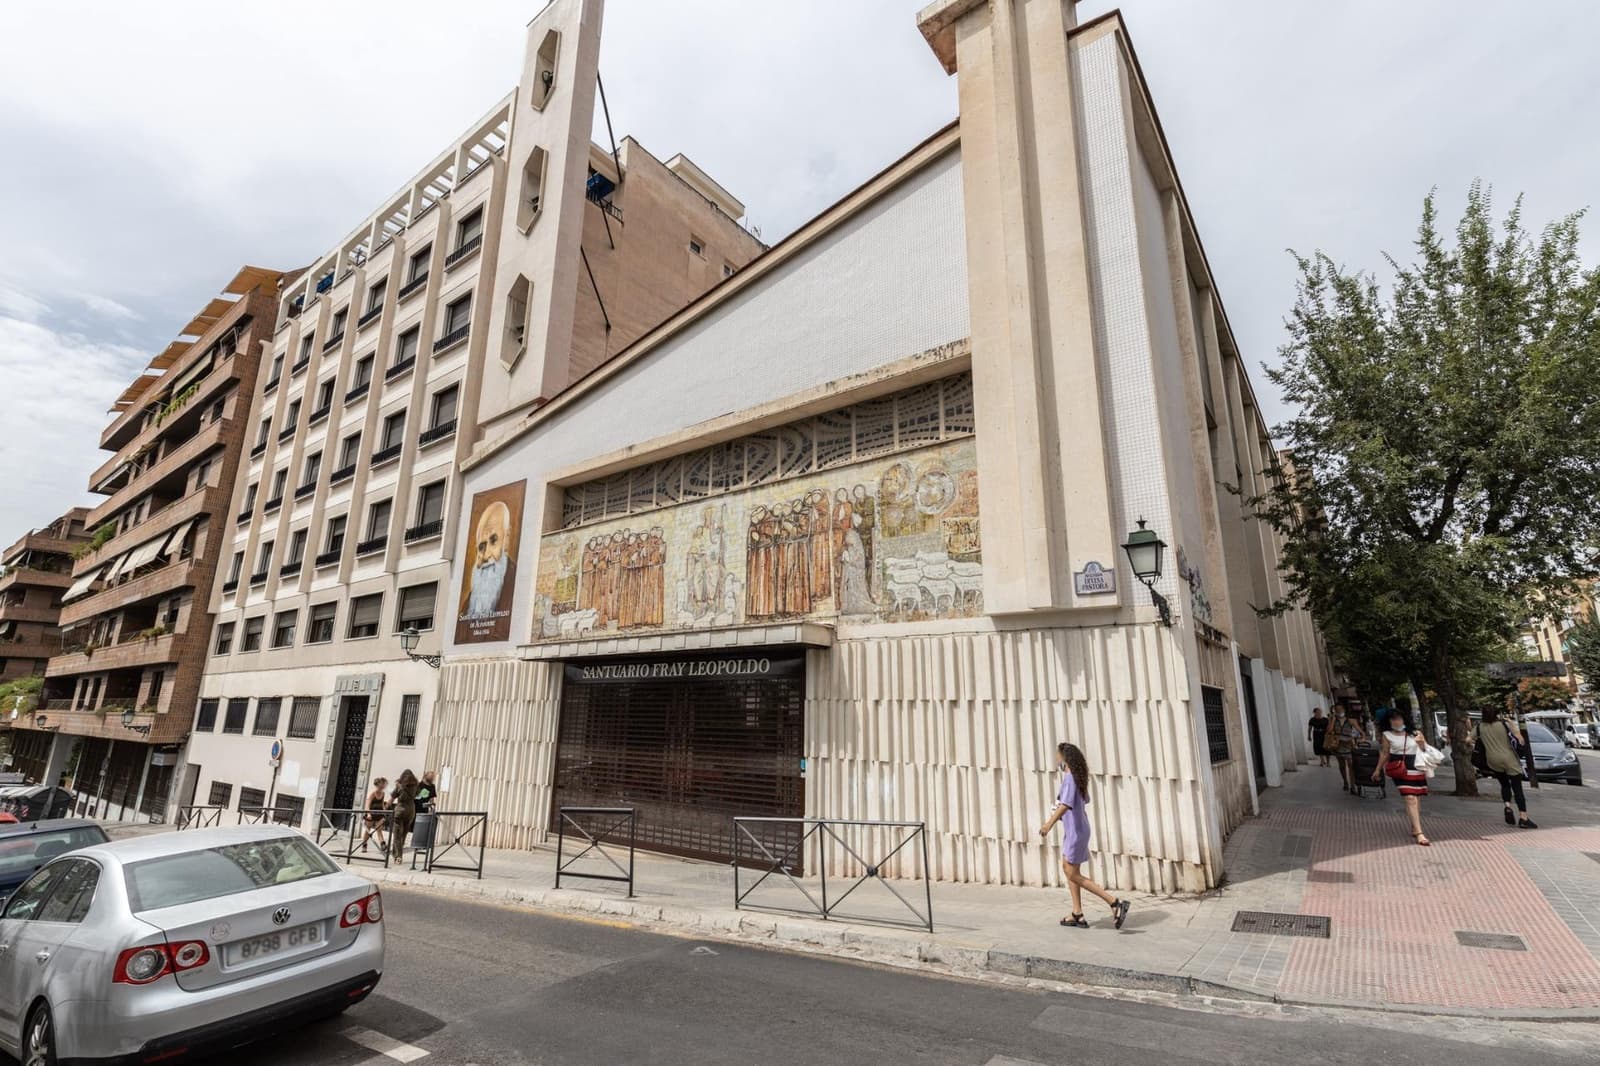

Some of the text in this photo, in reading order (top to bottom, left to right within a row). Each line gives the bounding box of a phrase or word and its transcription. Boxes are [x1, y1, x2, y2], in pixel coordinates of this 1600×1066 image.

[582, 658, 770, 679] SANTUARIO FRAY LEOPOLDO
[241, 926, 318, 959] 8798 GFB
